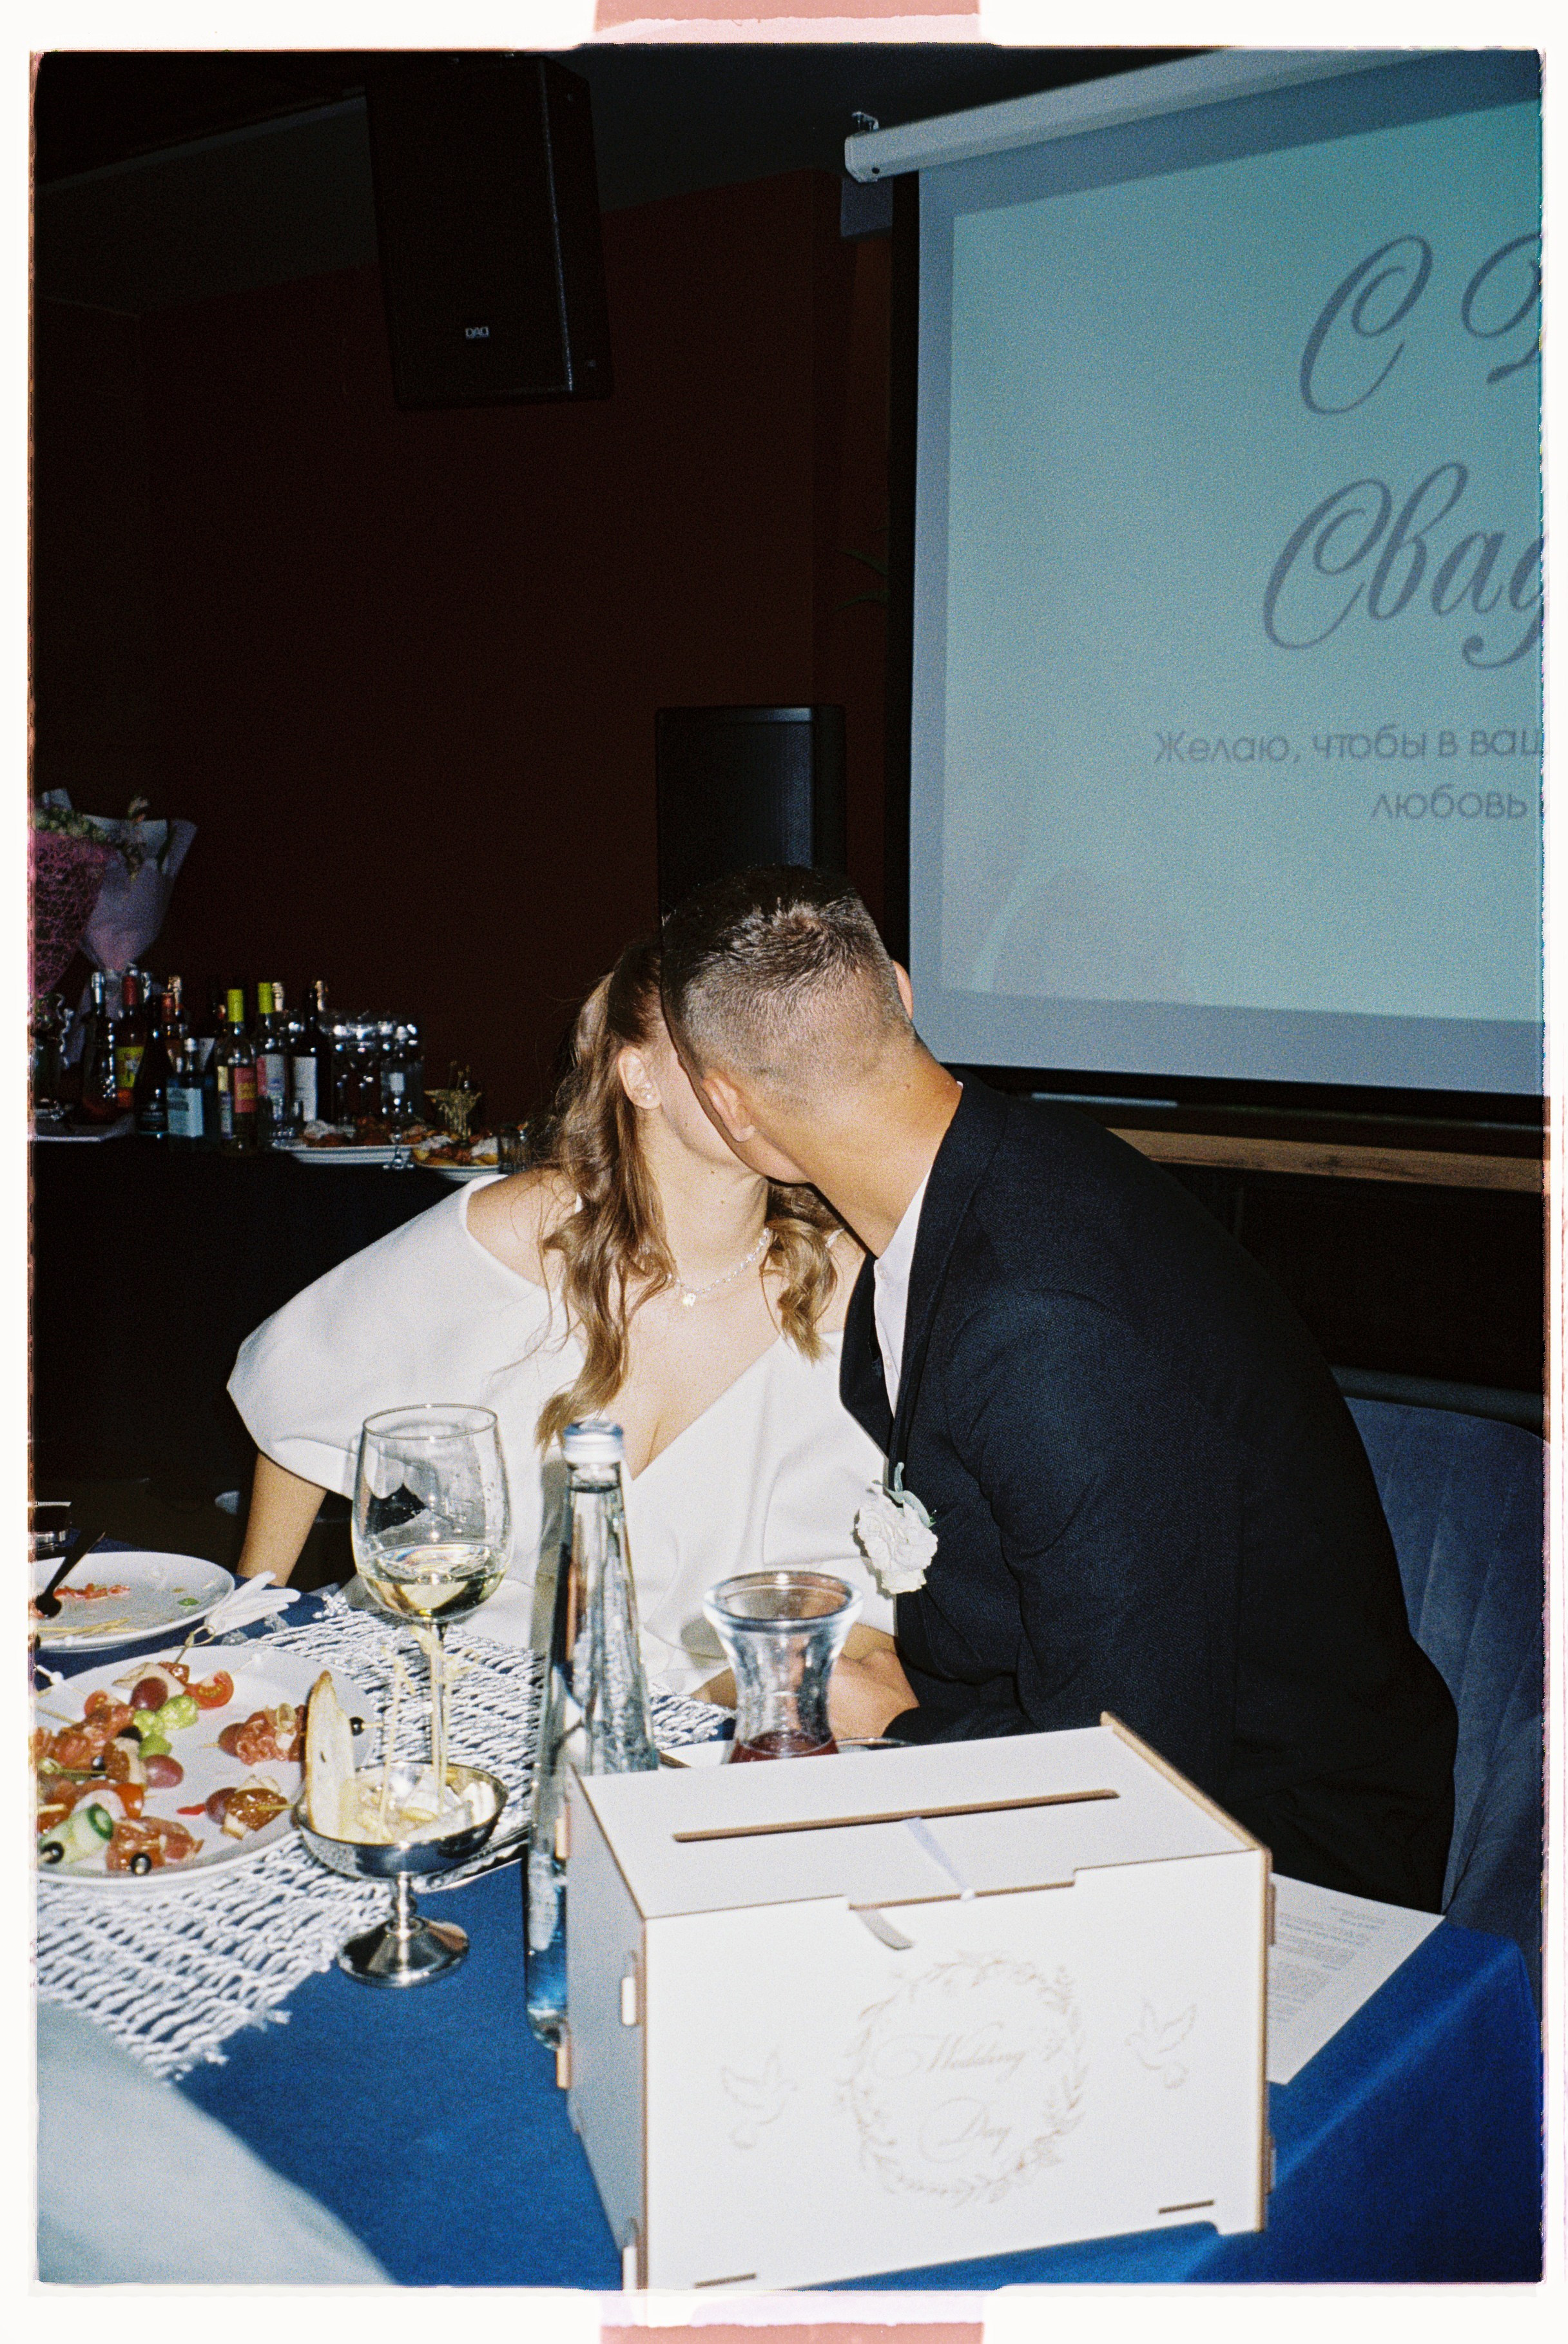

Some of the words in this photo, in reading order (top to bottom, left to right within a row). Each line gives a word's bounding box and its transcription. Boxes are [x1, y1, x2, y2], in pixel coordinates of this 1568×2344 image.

[1154, 730, 1301, 764] Желаю,
[1312, 723, 1427, 760] чтобы
[1437, 730, 1458, 758] в
[1371, 783, 1529, 820] любовь
[872, 2020, 1028, 2084] Wedding
[918, 2096, 1012, 2164] Day
